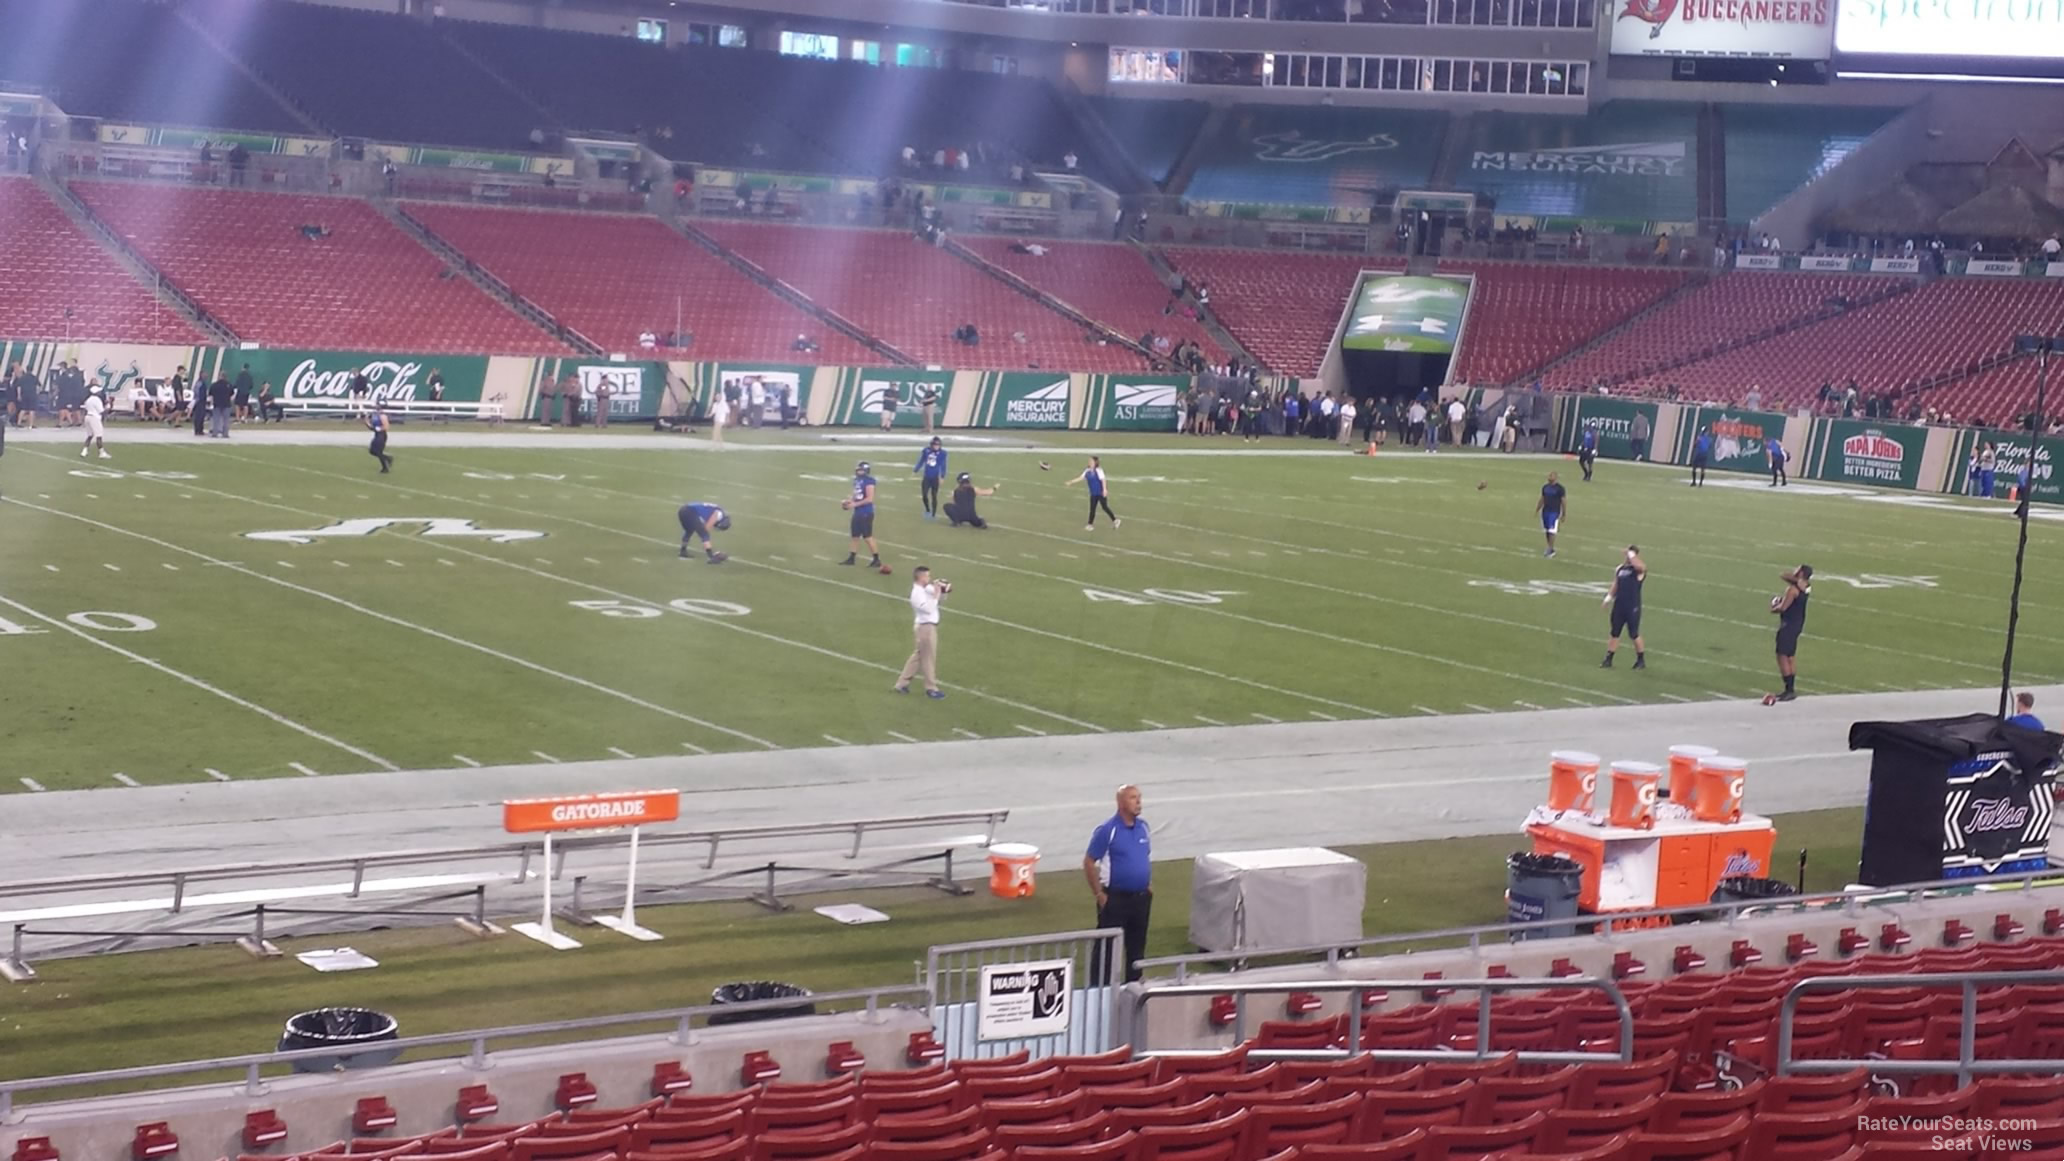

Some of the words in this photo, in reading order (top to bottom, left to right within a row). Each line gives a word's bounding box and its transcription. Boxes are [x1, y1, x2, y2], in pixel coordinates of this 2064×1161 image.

[1682, 0, 1828, 29] BUCCANEERS
[1473, 151, 1682, 167] MERCURY
[1471, 161, 1684, 176] INSURANCE
[578, 399, 640, 414] HELTH
[1007, 400, 1067, 413] MERCURY
[1114, 405, 1137, 420] ASI
[1006, 411, 1067, 423] INSURANCE
[1581, 416, 1631, 433] MOFFITT
[1711, 421, 1763, 439] HOOTERS
[1846, 438, 1869, 455] PAPA
[1843, 465, 1875, 478] BETTER
[1081, 588, 1223, 606] 40
[567, 598, 752, 618] 50
[1581, 773, 1596, 794] G
[1729, 777, 1745, 798] G
[1638, 783, 1656, 806] G
[551, 800, 646, 822] GATORADE
[1963, 796, 2029, 834] Tulsa
[1017, 864, 1030, 879] G
[992, 974, 1040, 991] WARNING
